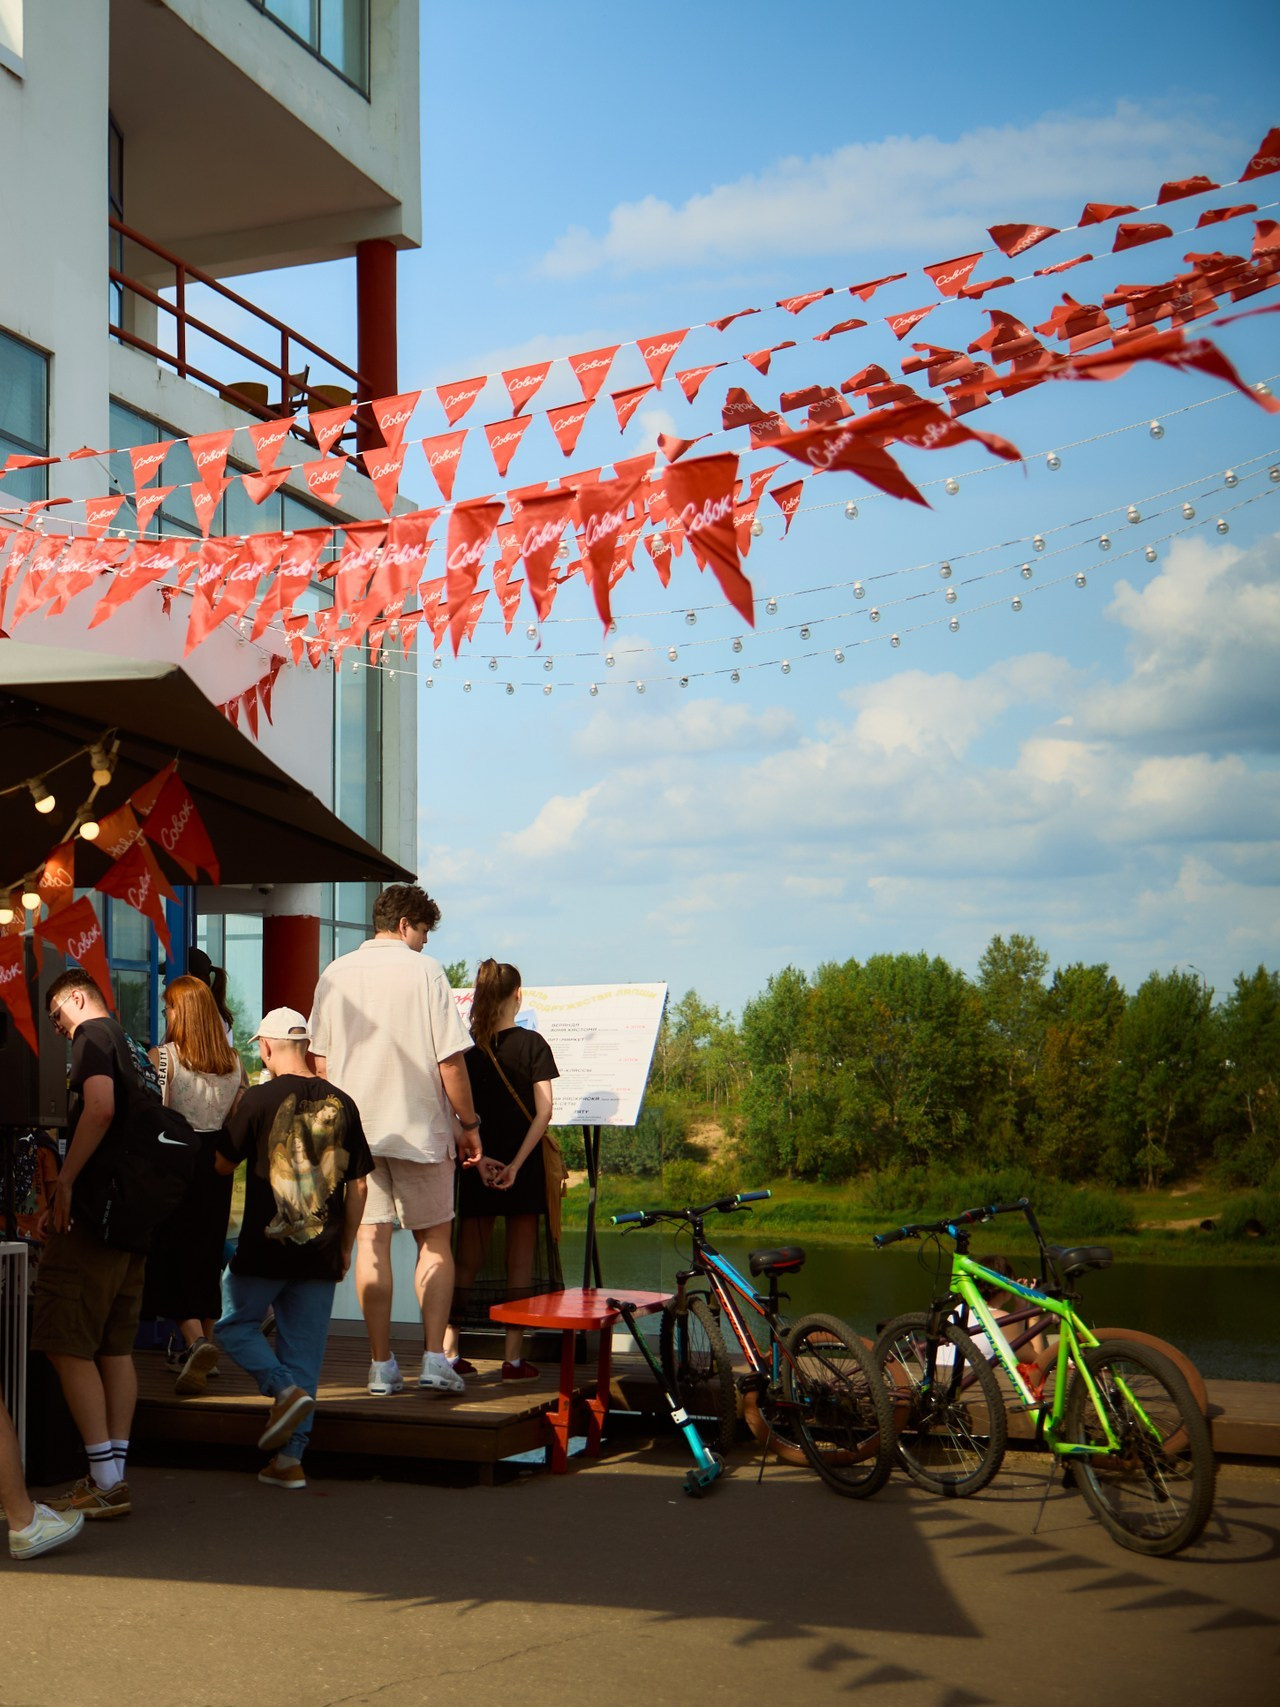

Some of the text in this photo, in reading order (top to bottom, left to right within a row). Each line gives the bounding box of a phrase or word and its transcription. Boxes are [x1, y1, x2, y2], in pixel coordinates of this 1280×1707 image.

[935, 262, 973, 286] Совок
[892, 310, 930, 330] Совок
[645, 341, 681, 359] Совок
[575, 356, 612, 373] Совок
[508, 374, 545, 391] Совок
[445, 389, 477, 409] Совок
[380, 409, 413, 429] Совок
[554, 412, 586, 432] Совок
[256, 431, 287, 451] Совок
[490, 430, 523, 449] Совок
[134, 452, 165, 469] Совок
[197, 447, 227, 467] Совок
[430, 446, 461, 467] Совок
[308, 470, 339, 488] Совок
[372, 460, 401, 480] Совок
[137, 494, 165, 508] Совок
[87, 508, 117, 523] Совок
[680, 494, 732, 536] Совок
[161, 798, 194, 850] Совок
[68, 922, 102, 960] Совок
